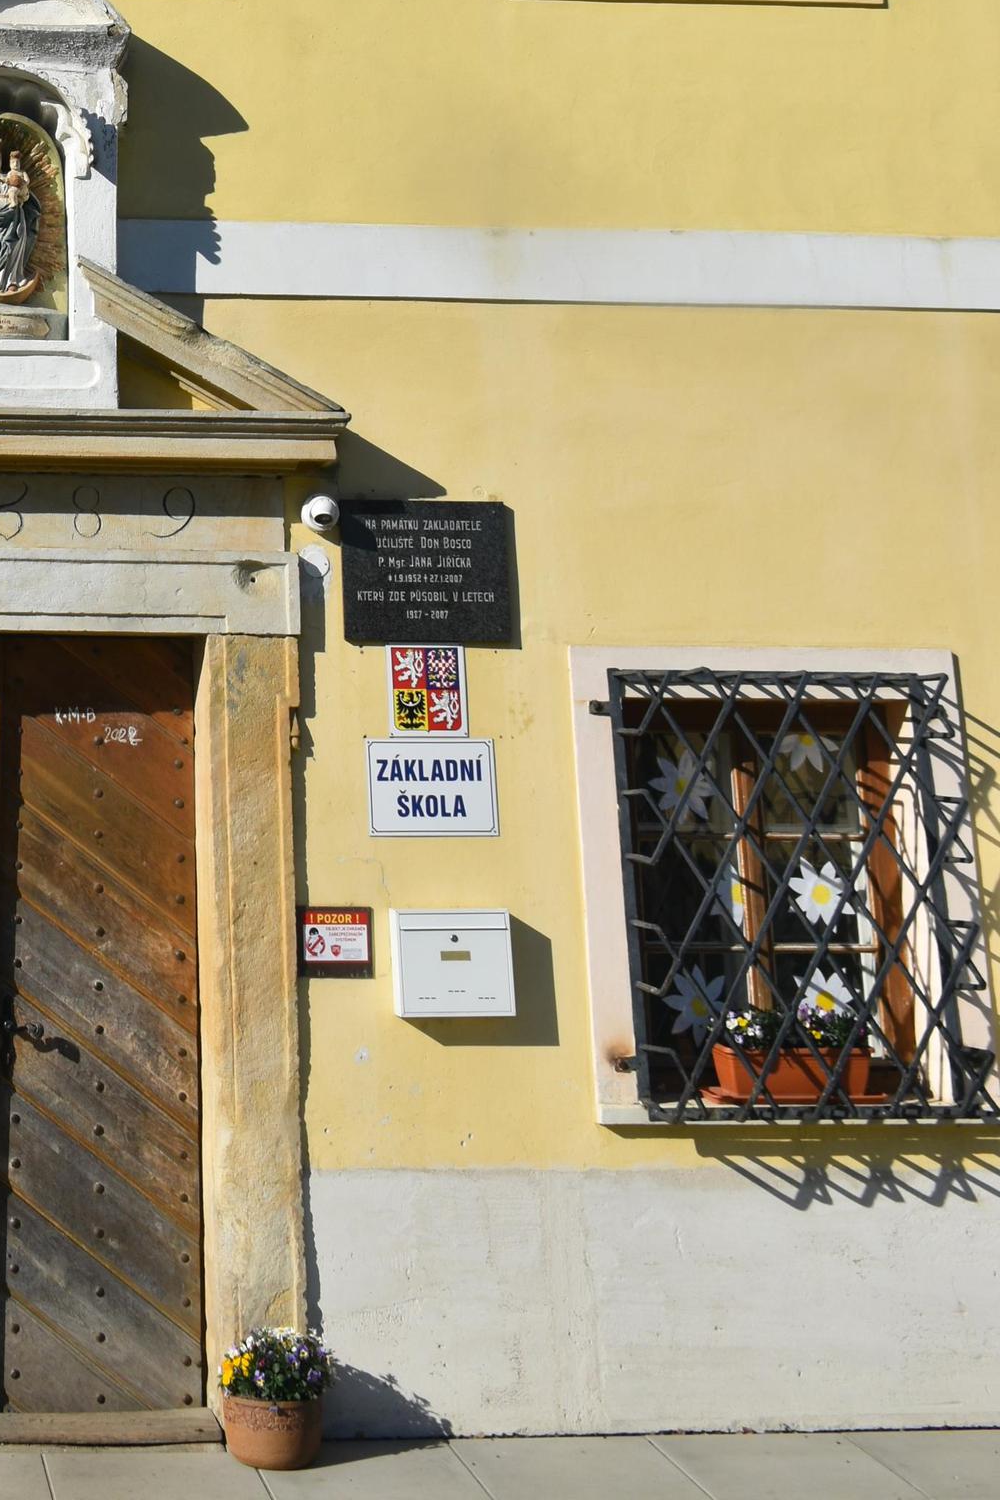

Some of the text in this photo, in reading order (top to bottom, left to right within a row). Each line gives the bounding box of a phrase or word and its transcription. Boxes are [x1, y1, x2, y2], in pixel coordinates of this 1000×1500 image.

[381, 519, 418, 530] PAMÁTKU
[423, 520, 481, 531] ZAKLADATELE
[378, 557, 386, 567] P.
[357, 589, 494, 602] KTERÝ ZDE PŮSOBIL V LETECH
[376, 755, 482, 782] ZÁKLADNÍ
[397, 791, 467, 818] ŠKOLA
[317, 914, 352, 923] POZOR
